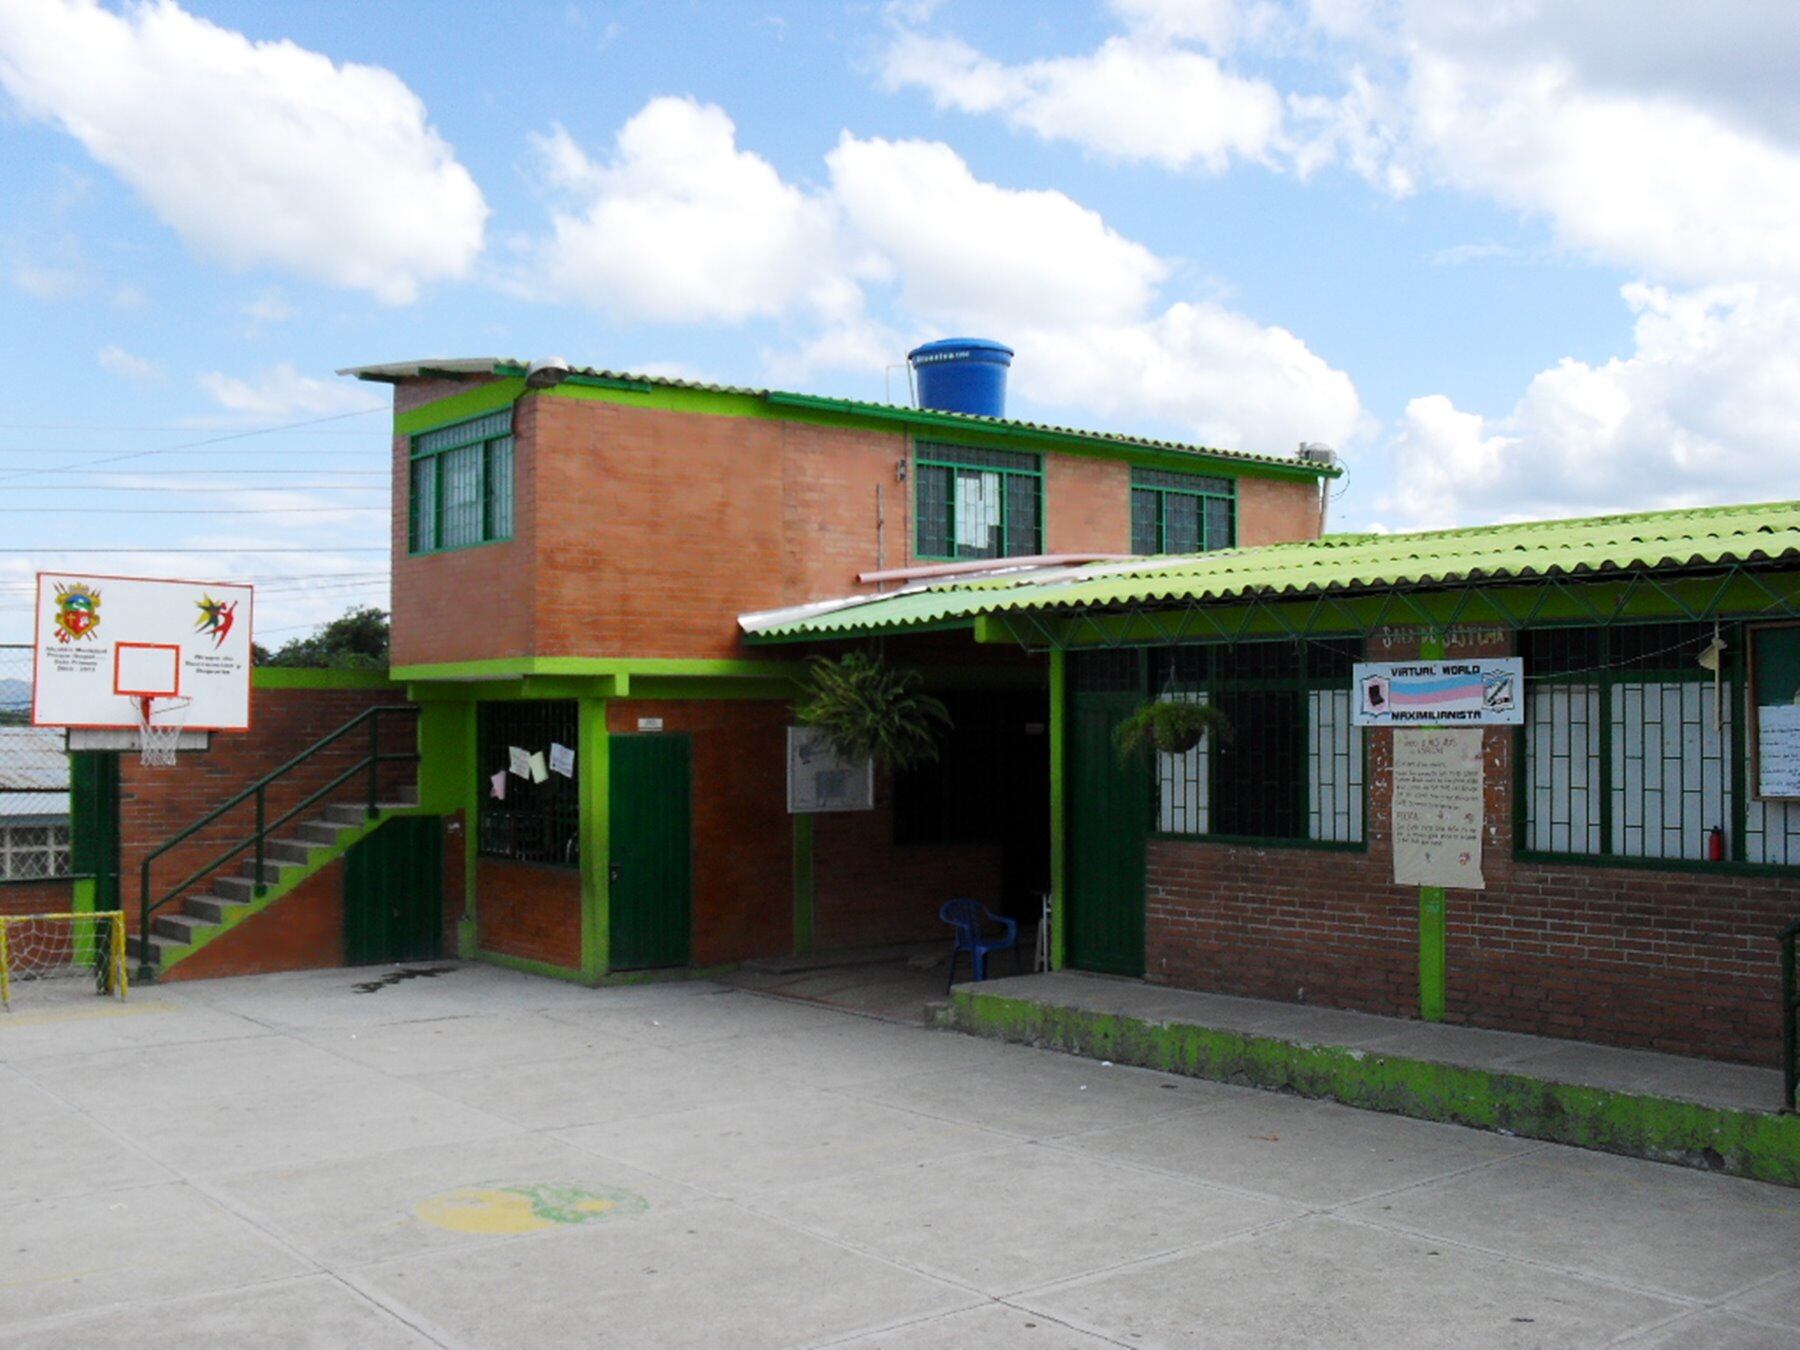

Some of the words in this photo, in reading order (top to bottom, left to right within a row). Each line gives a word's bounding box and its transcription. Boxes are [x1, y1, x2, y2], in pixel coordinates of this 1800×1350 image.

[1391, 666, 1436, 677] VIRTUAL
[1442, 665, 1480, 675] WORLD
[1391, 711, 1482, 720] MAXIMILIANISTA
